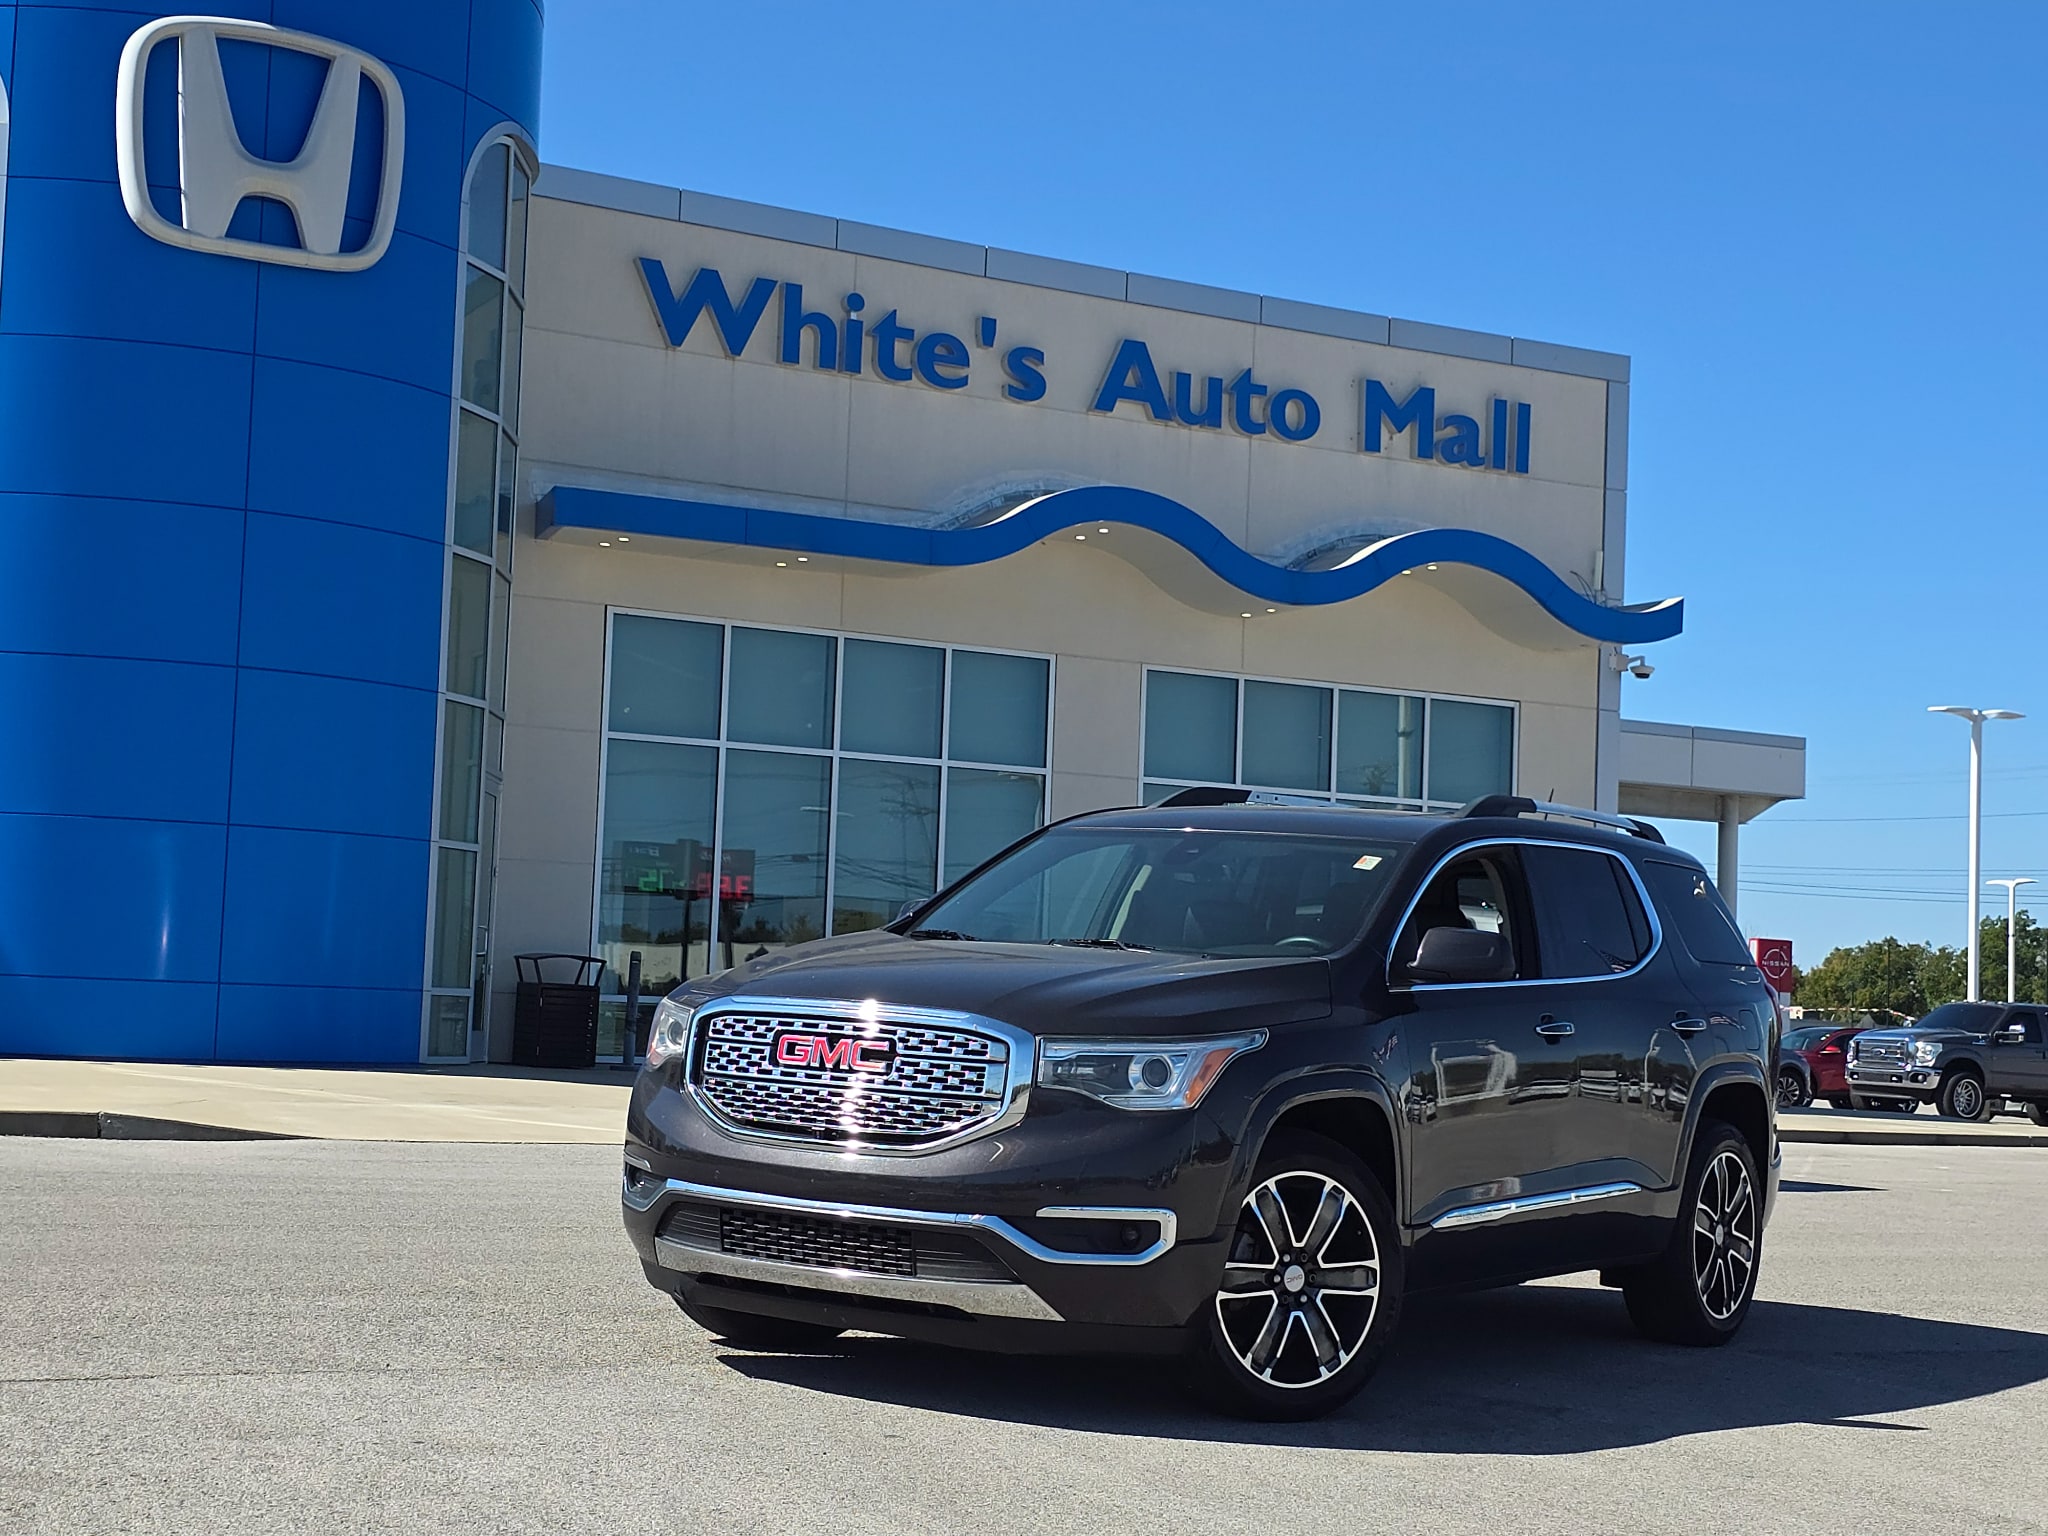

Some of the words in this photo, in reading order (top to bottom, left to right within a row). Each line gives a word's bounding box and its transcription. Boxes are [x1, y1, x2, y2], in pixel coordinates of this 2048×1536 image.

[634, 256, 1047, 402] White's
[1090, 338, 1321, 443] Auto
[1361, 378, 1531, 474] Mall
[777, 1034, 889, 1072] GMC
